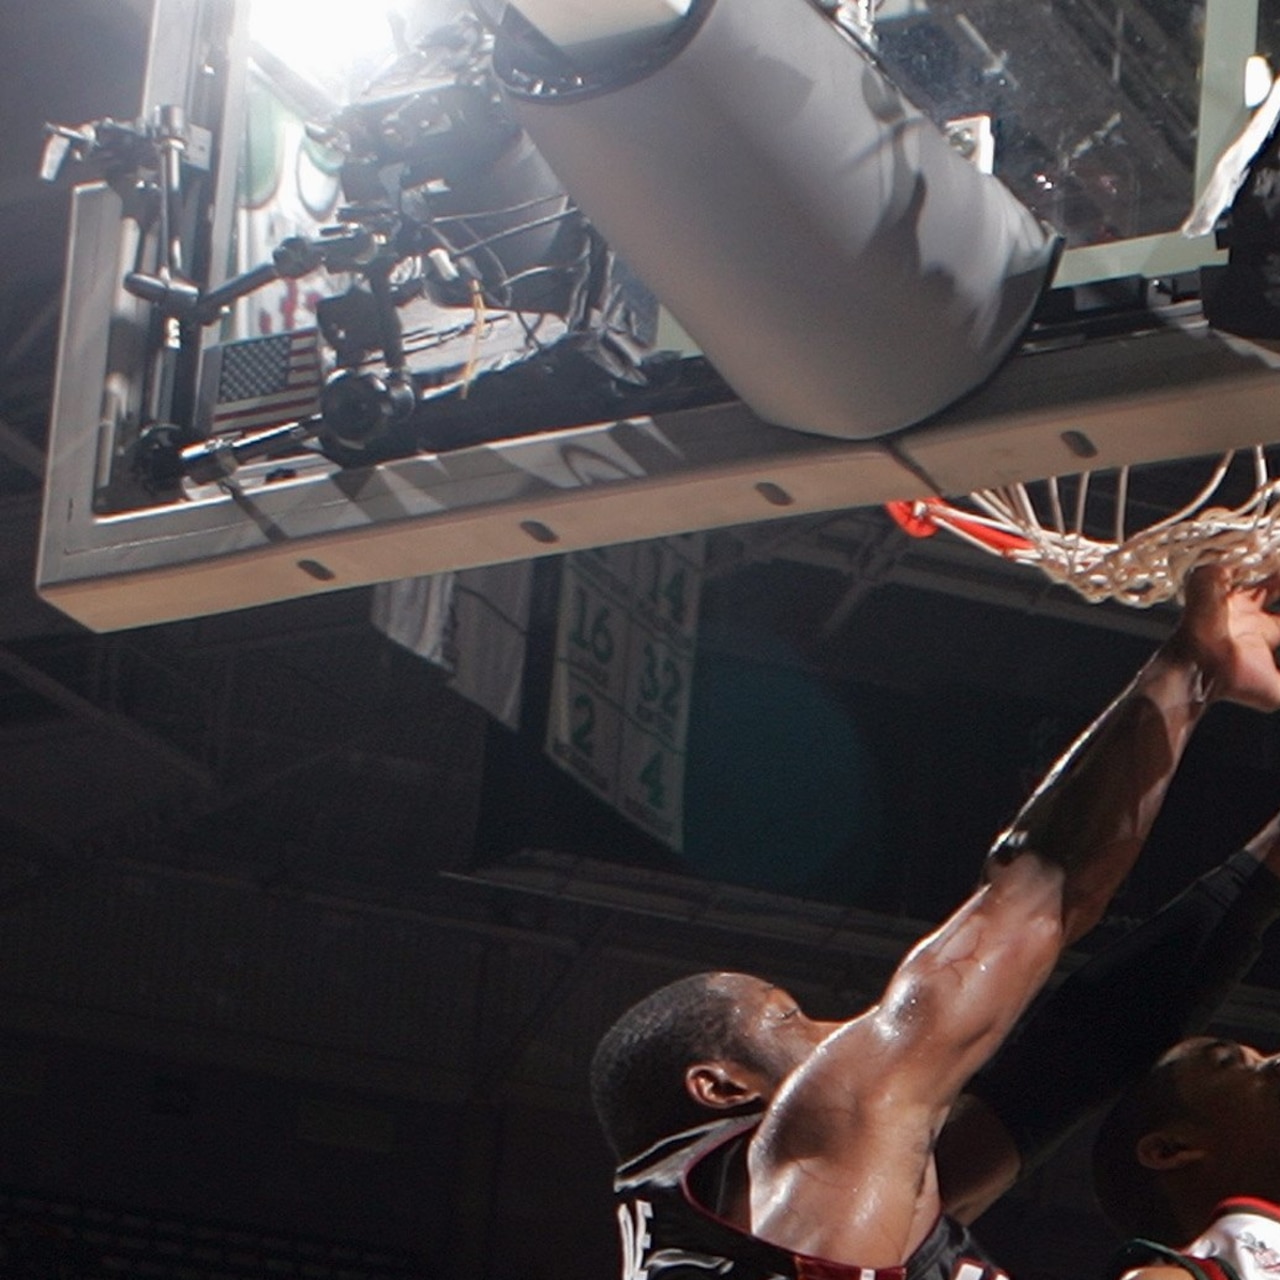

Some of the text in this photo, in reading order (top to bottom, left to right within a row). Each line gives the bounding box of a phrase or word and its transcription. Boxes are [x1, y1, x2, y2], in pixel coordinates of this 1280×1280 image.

[570, 586, 615, 665] 16
[639, 643, 682, 718] 32
[570, 694, 596, 757] 2
